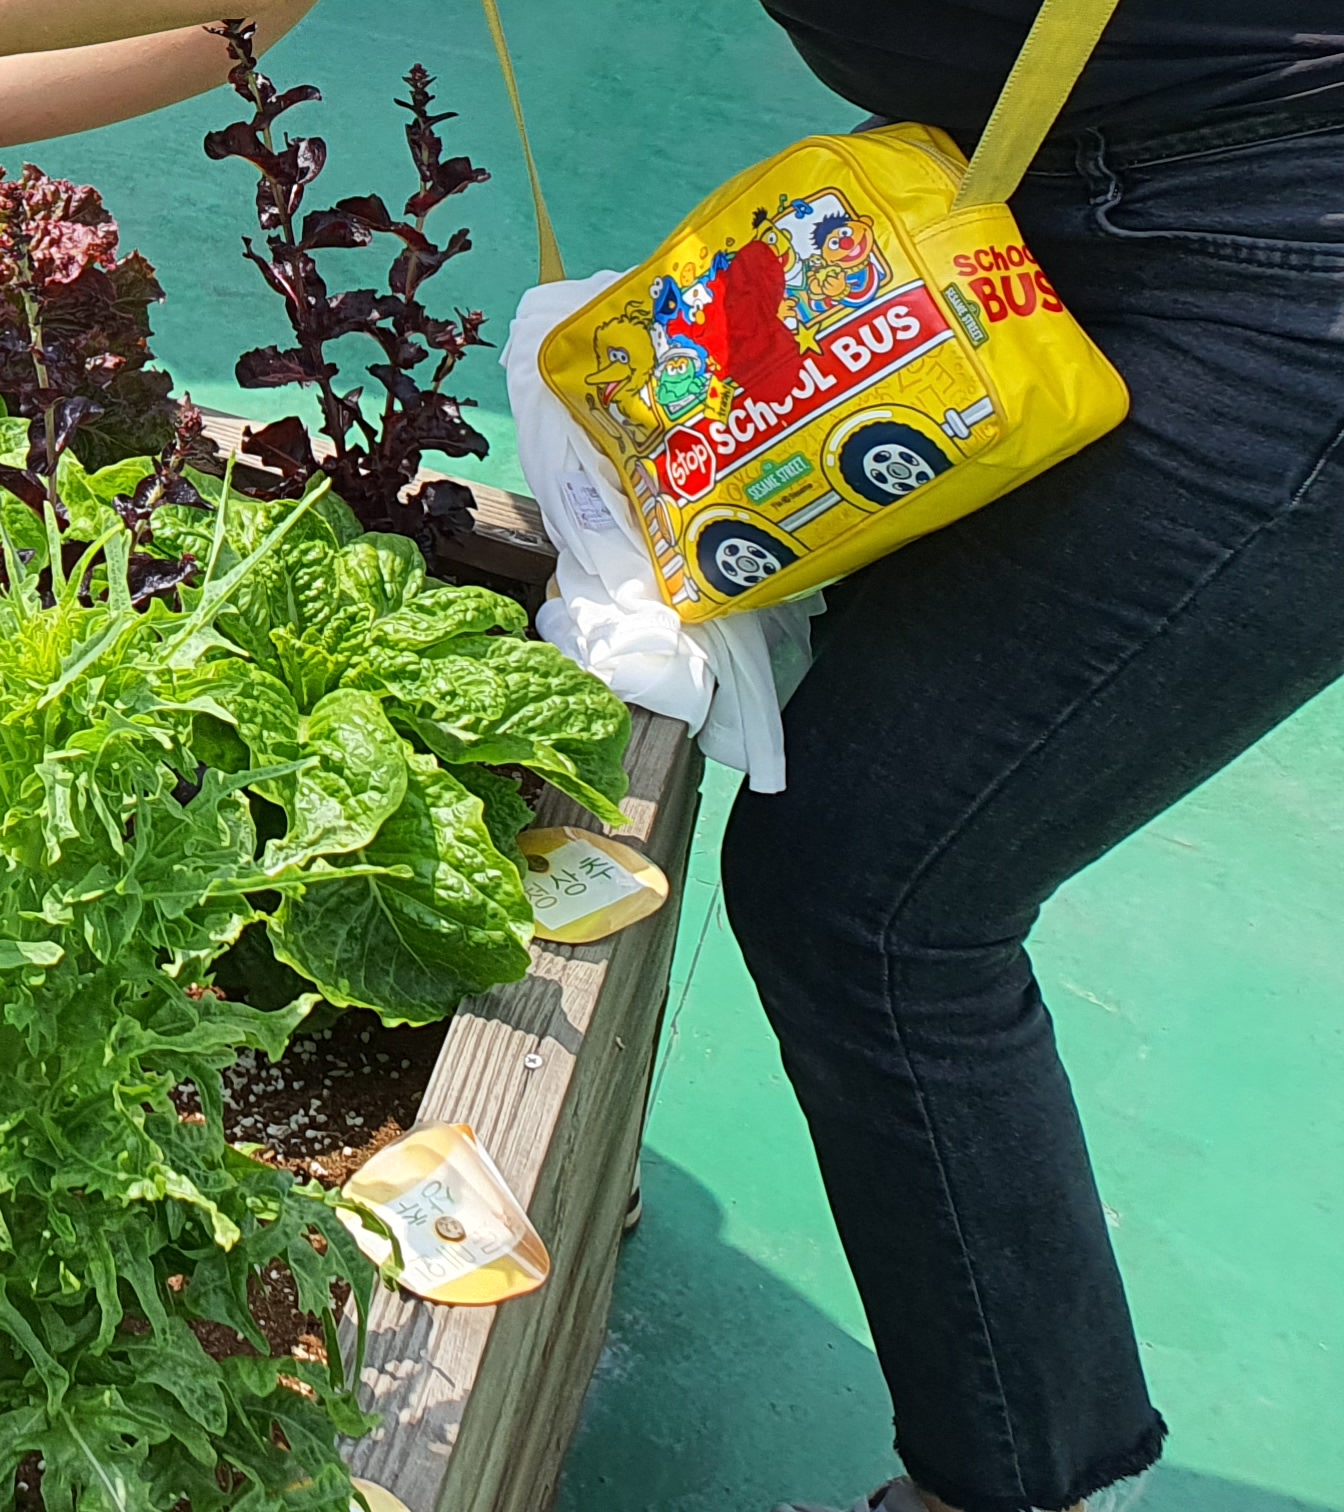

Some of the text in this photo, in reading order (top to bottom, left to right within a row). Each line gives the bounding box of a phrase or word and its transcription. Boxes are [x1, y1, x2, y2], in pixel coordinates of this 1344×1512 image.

[968, 270, 1064, 323] BUS
[830, 305, 921, 374] BUS
[672, 444, 708, 486] stop
